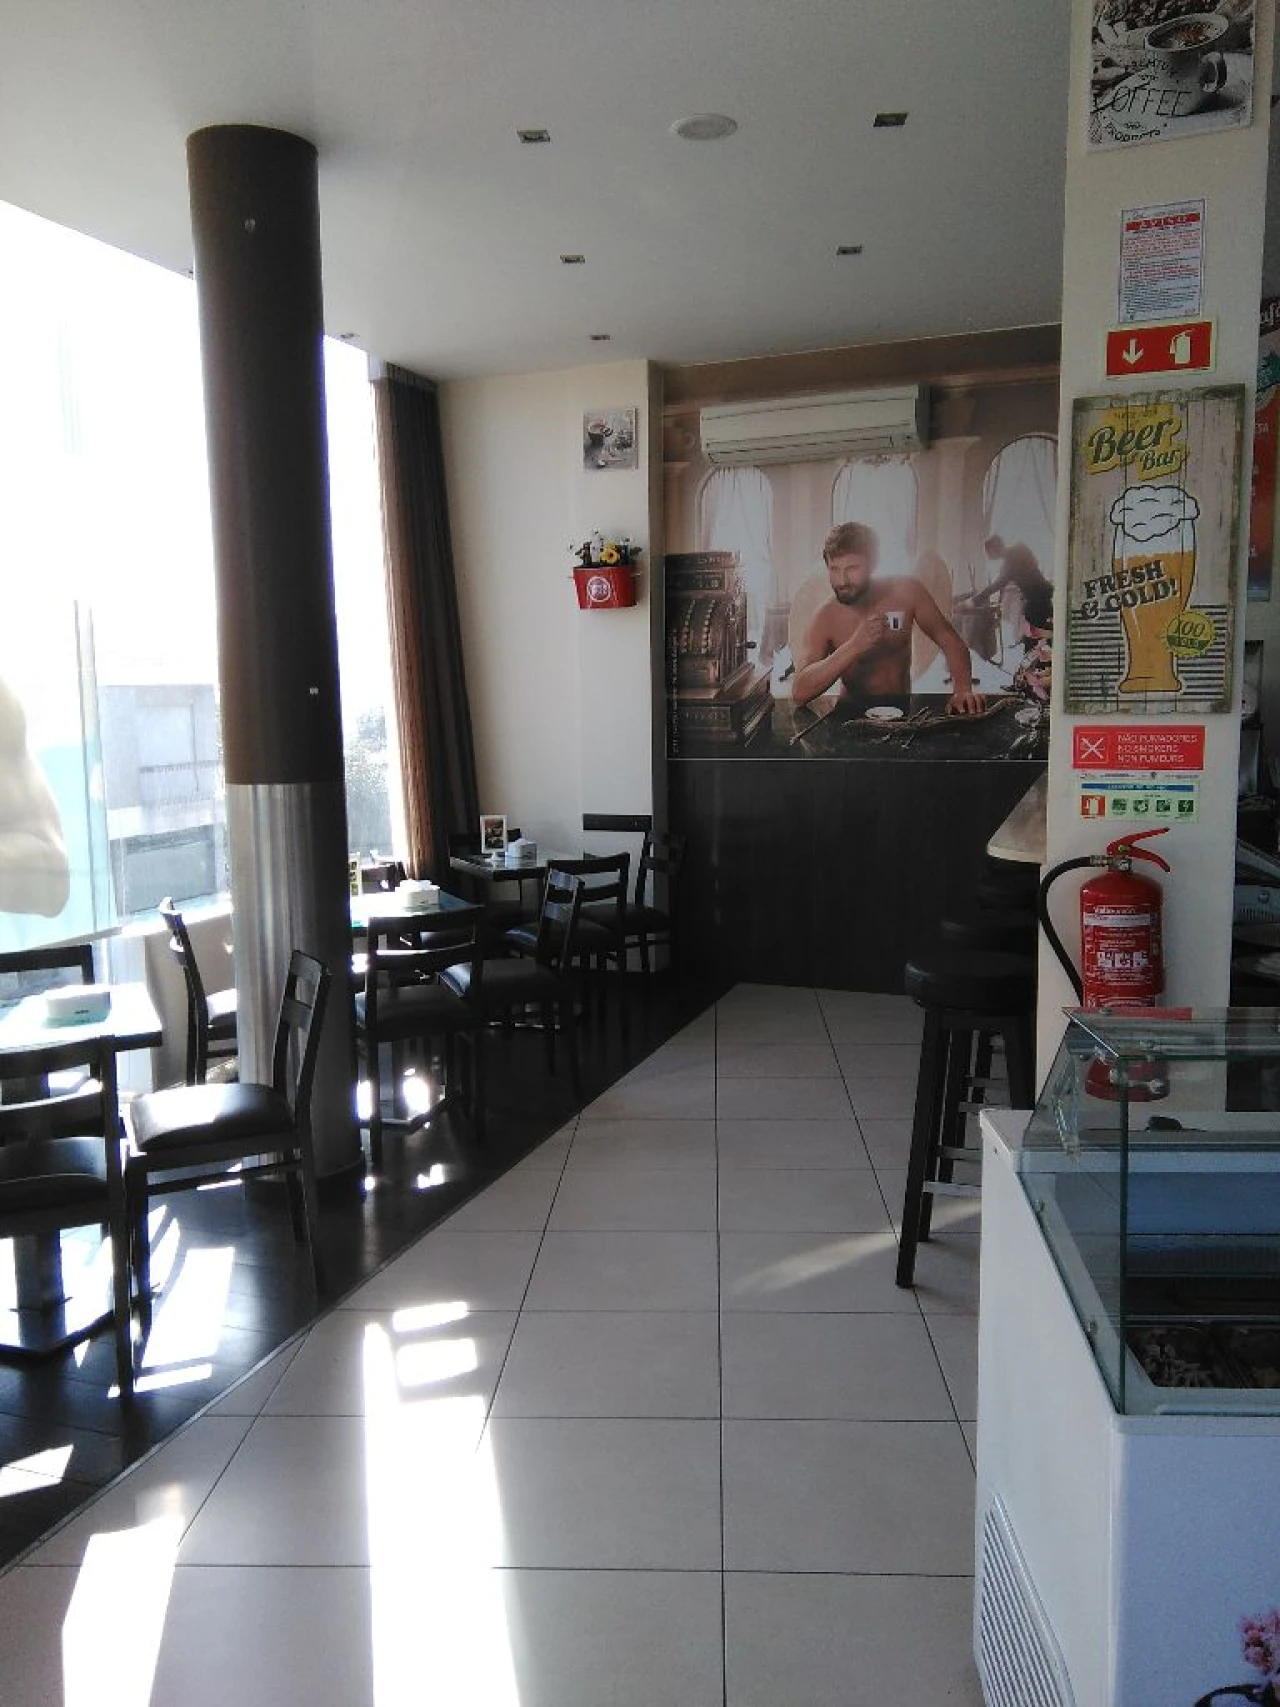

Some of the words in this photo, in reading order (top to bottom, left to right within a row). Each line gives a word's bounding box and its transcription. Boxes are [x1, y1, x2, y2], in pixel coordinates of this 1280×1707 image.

[1088, 419, 1174, 464] Beer
[1139, 449, 1180, 472] Bar
[1080, 600, 1100, 621] &
[1104, 577, 1178, 611] COLD!
[1083, 559, 1166, 599] FRESH
[1173, 620, 1206, 638] 100
